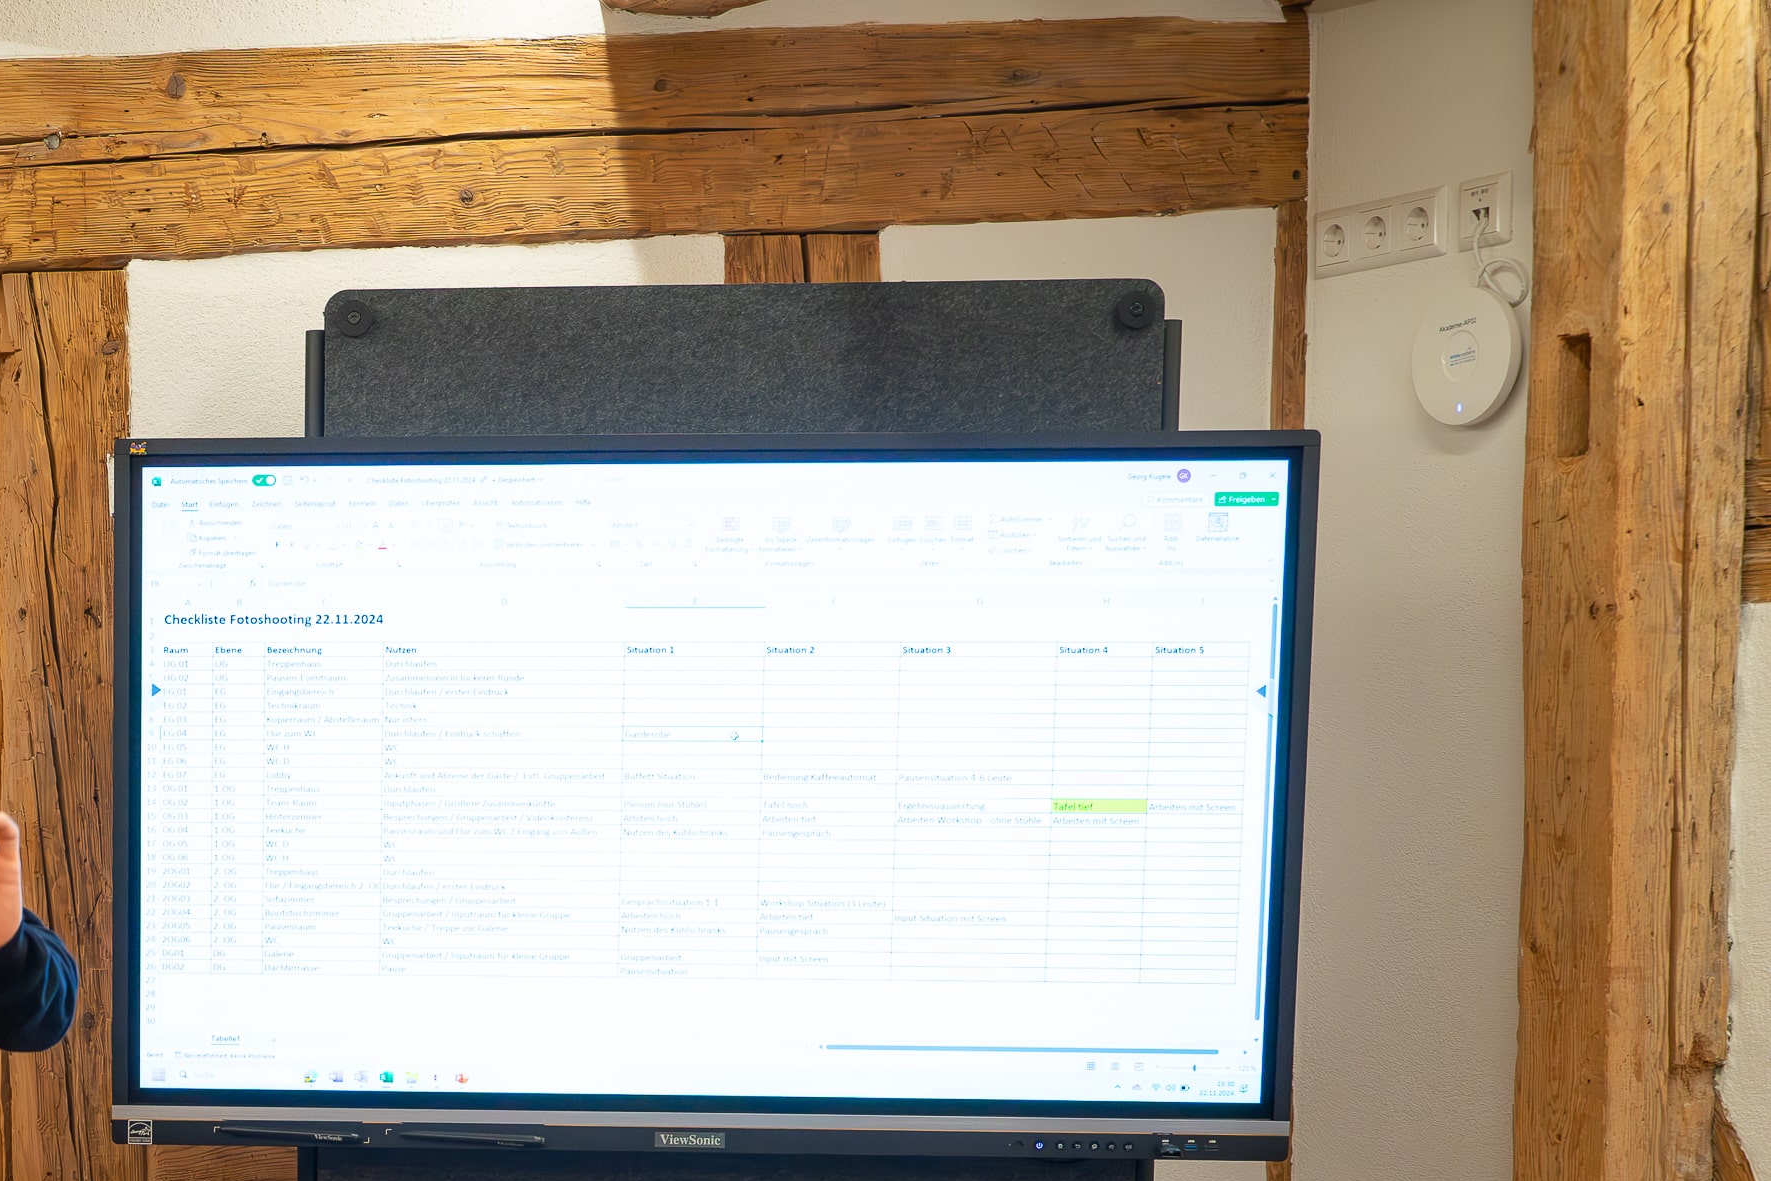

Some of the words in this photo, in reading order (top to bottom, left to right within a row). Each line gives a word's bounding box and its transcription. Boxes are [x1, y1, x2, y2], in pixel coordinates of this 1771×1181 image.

[1229, 495, 1265, 504] Freigeben
[180, 500, 202, 509] Start
[164, 613, 226, 625] Checkliste
[230, 613, 312, 627] Fotoshooting
[315, 613, 384, 625] 22.11.2024
[164, 645, 189, 654] Raum
[215, 645, 242, 654] Ebene
[266, 645, 323, 656] Bezeichnung
[386, 645, 417, 654] Nutzen
[627, 645, 666, 654] Situation
[669, 645, 674, 654] 1
[766, 645, 806, 654] Situation
[809, 645, 815, 654] 2
[902, 645, 943, 654] Situation
[945, 645, 951, 654] 3
[1059, 645, 1099, 654] Situation
[1102, 645, 1108, 654] 4
[1155, 645, 1196, 654] Situation
[1198, 645, 1204, 654] 5
[660, 1133, 721, 1146] ViewSonic
